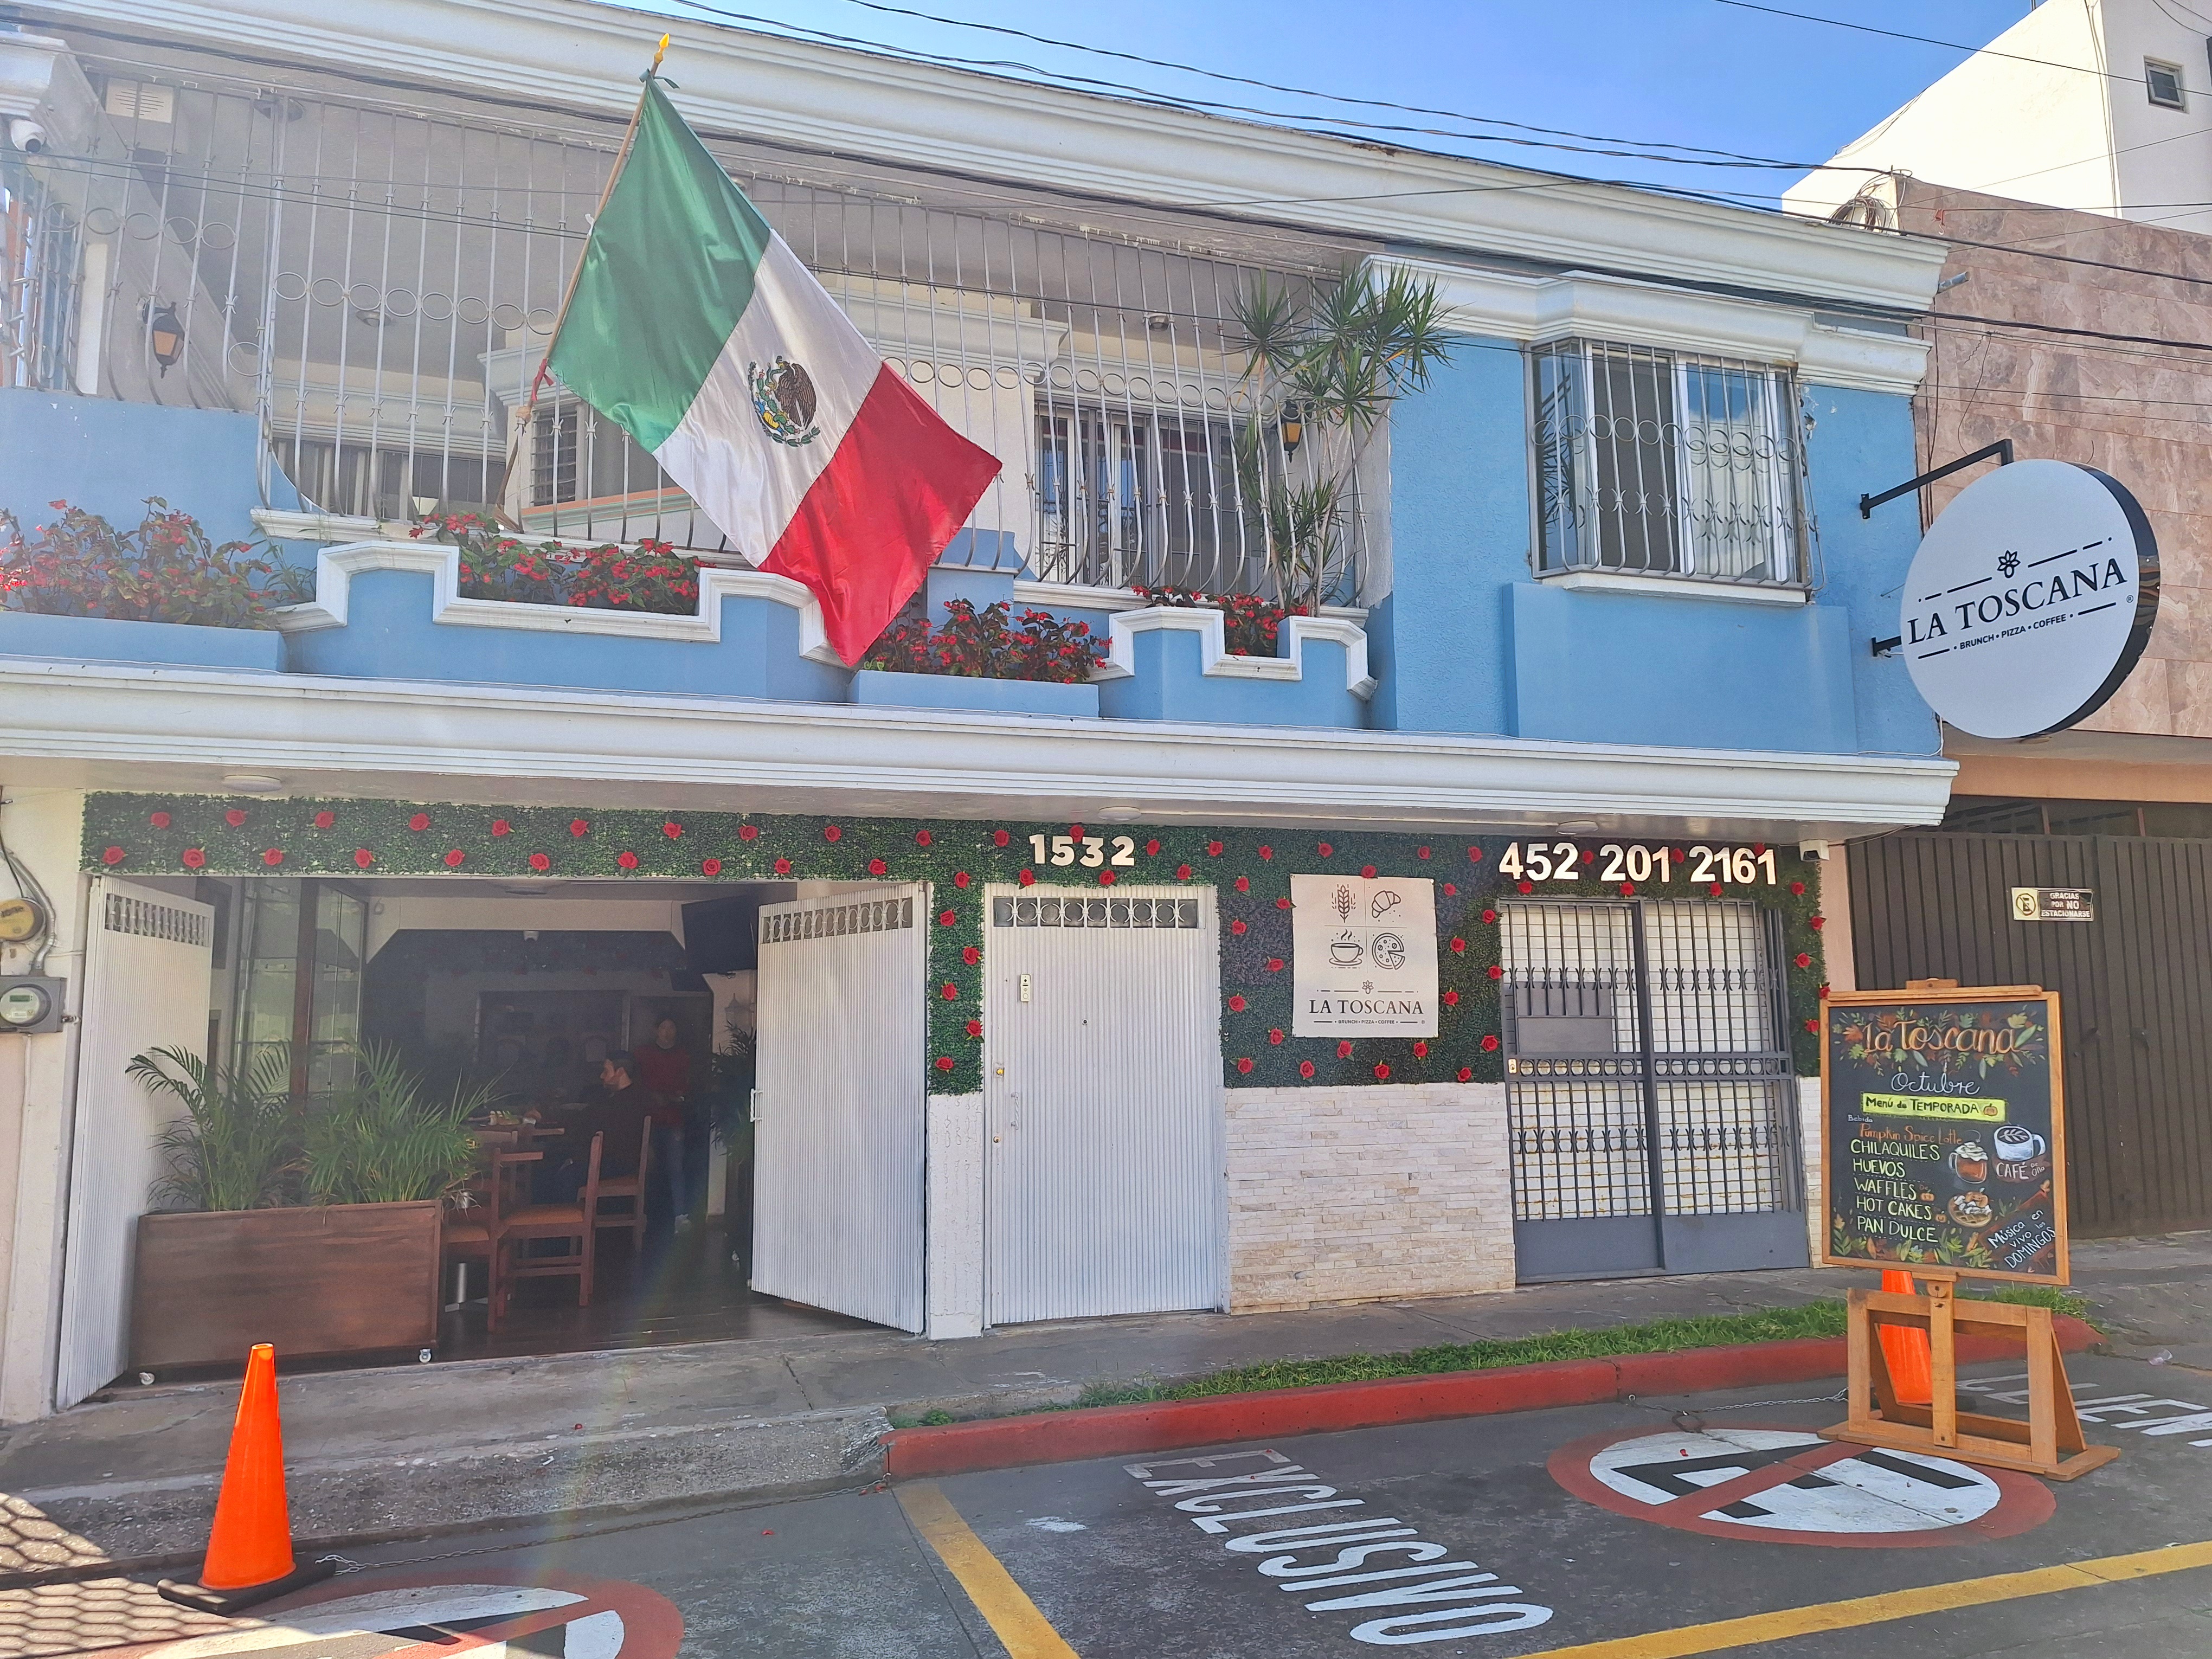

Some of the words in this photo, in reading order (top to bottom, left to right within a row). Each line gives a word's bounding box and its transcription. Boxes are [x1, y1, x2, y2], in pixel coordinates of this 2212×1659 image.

[1907, 612, 1948, 645] LA
[1955, 558, 2128, 631] TOSCANA
[1960, 634, 1994, 650] BRUNCH
[2001, 625, 2026, 638] PIZZA
[2034, 614, 2066, 629] COFFEE
[1029, 834, 1134, 867] 1532
[1499, 842, 1579, 881] 452
[1599, 844, 1670, 882] 201
[1688, 846, 1776, 885] 2161
[2066, 901, 2080, 909] NO
[1309, 1000, 1332, 1013] LA
[1338, 1000, 1424, 1014] TOSCANA
[1862, 1021, 1894, 1053] La
[1894, 1020, 2022, 1054] Toscana
[1891, 1069, 1980, 1095] Octubre
[1866, 1096, 1893, 1108] Menú
[1909, 1098, 1979, 1114] TEMPORADA
[1848, 1114, 1873, 1123] Bebida
[1859, 1123, 1900, 1142] Pumpkin
[1850, 1139, 1940, 1161] CHILAQUILES
[1853, 1158, 1905, 1178] HUEVOS
[1996, 1162, 2029, 1179] CAFÉ
[1854, 1177, 1917, 1200] WAFFLES
[1856, 1195, 1884, 1212] HOT
[1888, 1201, 1932, 1220] CAKES
[1857, 1216, 1883, 1234] PAN
[1889, 1221, 1938, 1243] DULCE
[1988, 1221, 2025, 1249] Música
[2031, 1209, 2044, 1220] en
[2009, 1231, 2032, 1248] vivo
[2004, 1226, 2056, 1268] DOMINGOS
[1122, 1449, 1554, 1645] EXCLUSIVO
